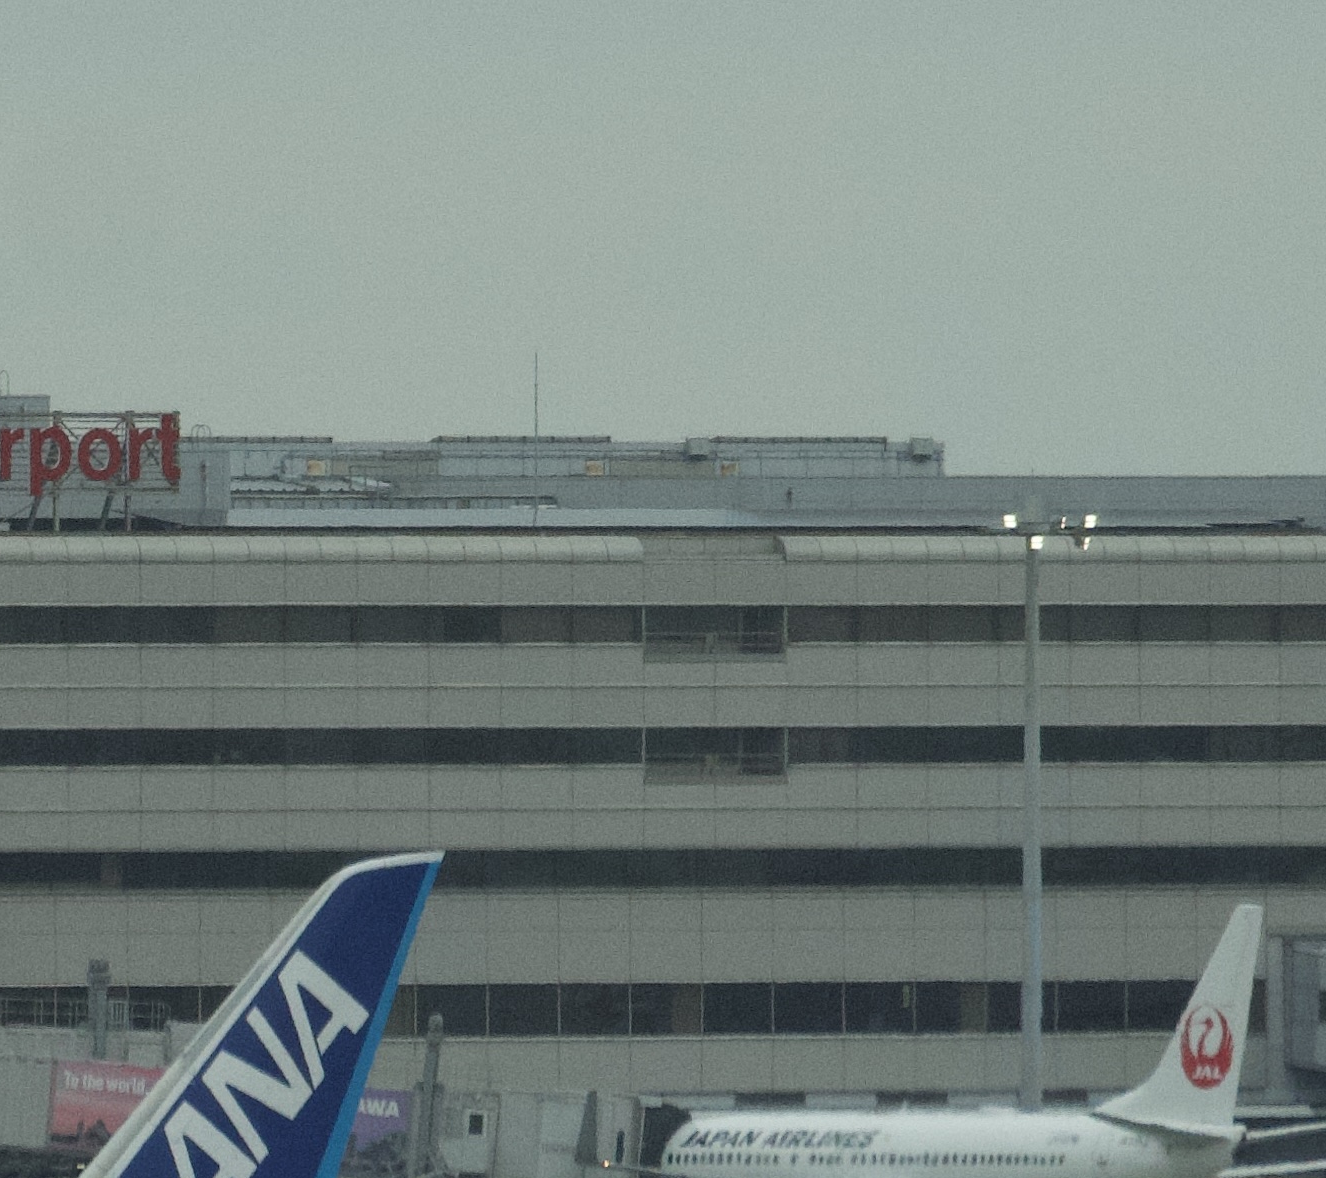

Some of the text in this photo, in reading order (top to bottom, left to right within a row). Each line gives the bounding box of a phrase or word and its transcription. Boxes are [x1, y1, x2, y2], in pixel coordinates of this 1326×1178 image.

[1192, 1064, 1225, 1079] JAL
[82, 1073, 104, 1092] the
[679, 1129, 880, 1148] JAPAN AIRLINES
